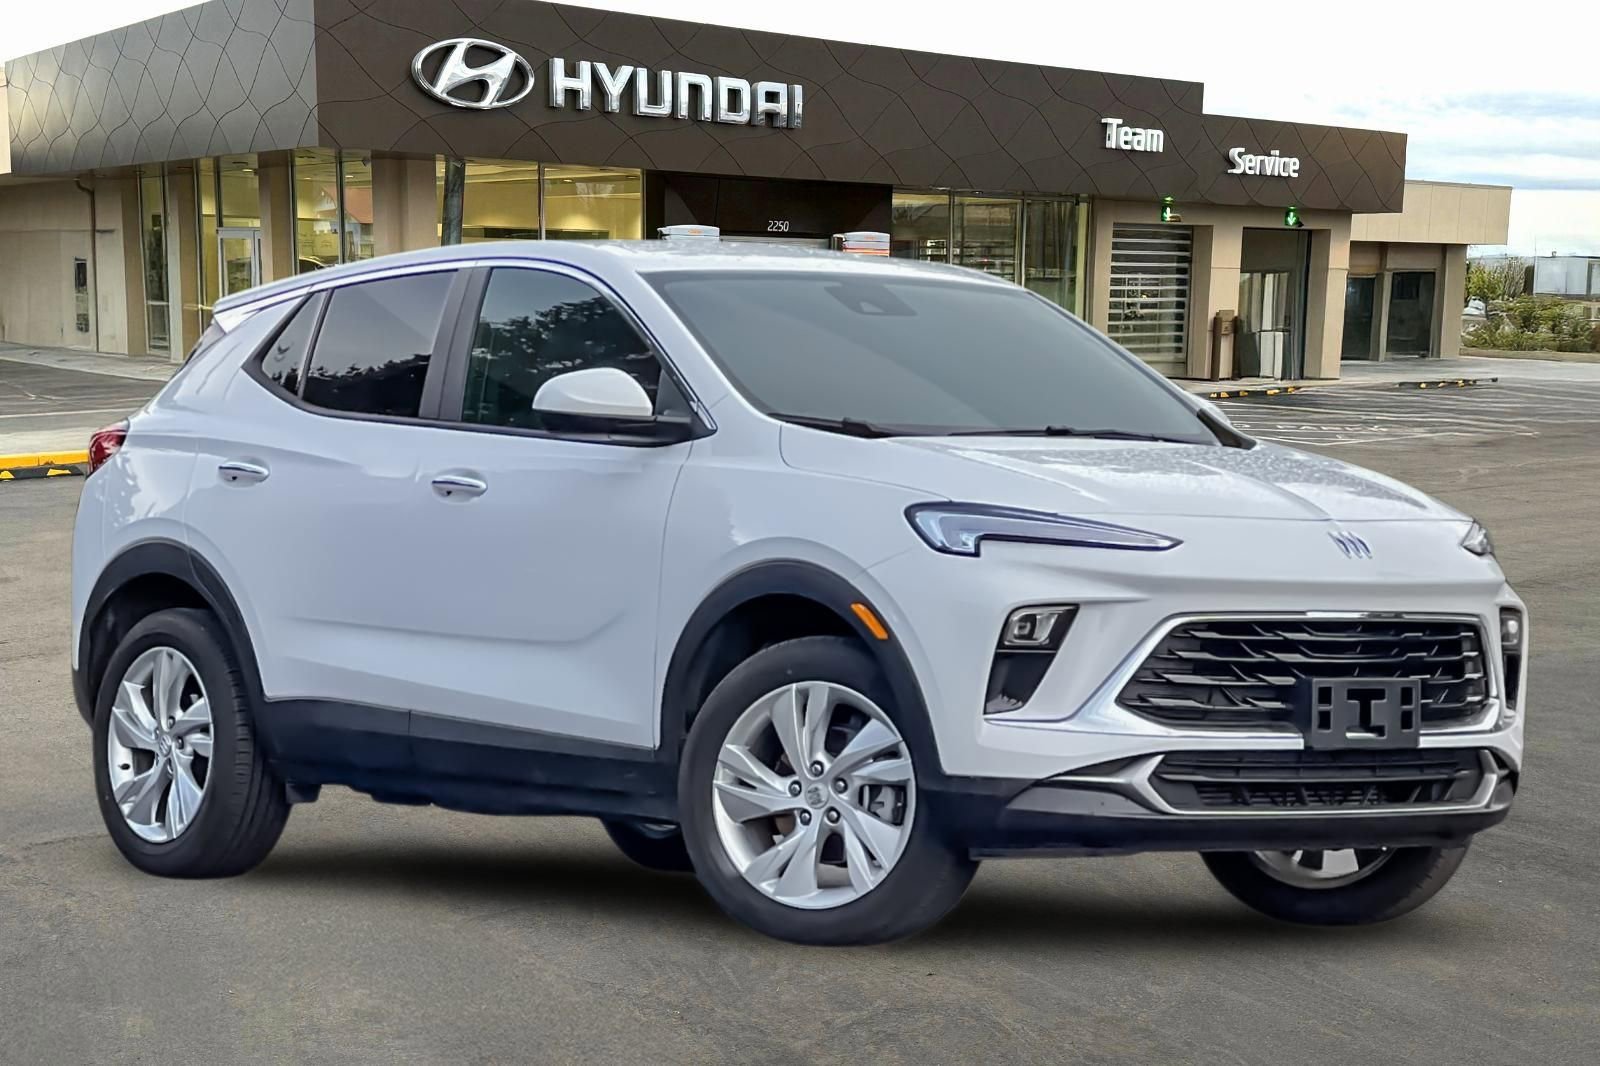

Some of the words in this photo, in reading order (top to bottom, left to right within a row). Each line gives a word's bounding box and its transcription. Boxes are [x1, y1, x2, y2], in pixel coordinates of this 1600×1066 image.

[549, 57, 803, 128] HYUNDAI
[1101, 117, 1164, 152] Team
[1227, 147, 1300, 177] Service
[767, 220, 789, 232] 2250
